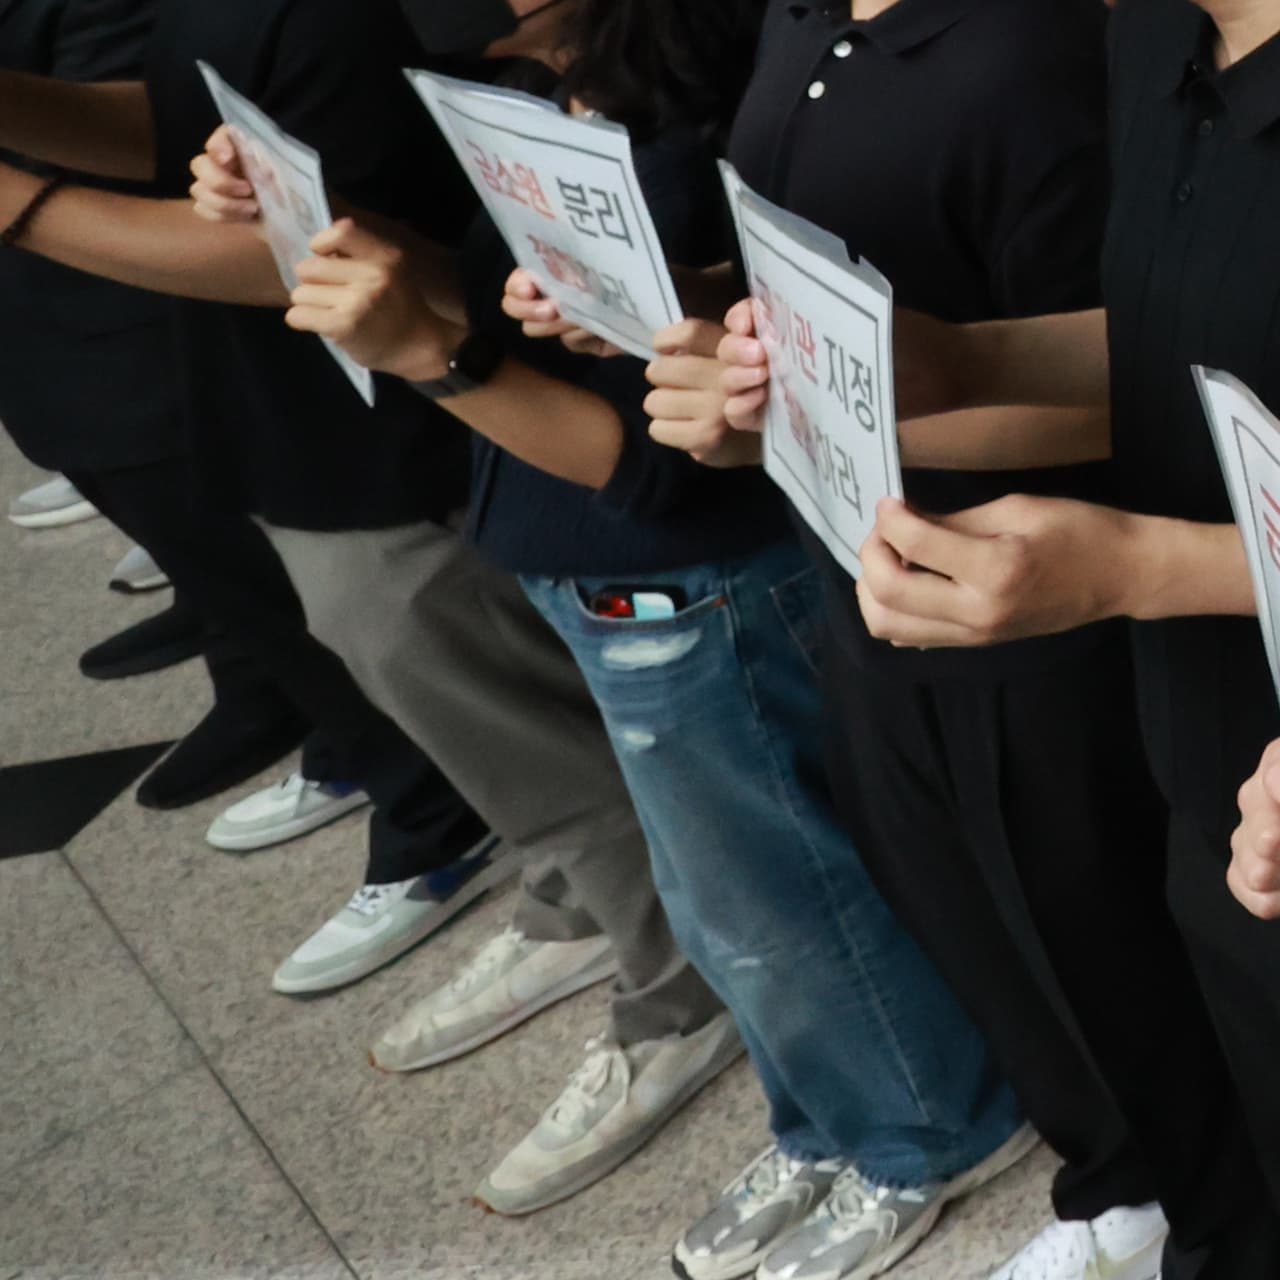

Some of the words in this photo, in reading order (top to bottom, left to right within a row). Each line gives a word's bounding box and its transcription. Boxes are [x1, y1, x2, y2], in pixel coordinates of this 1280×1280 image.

[465, 138, 558, 221] 금소원
[556, 176, 635, 250] 분리
[823, 334, 877, 434] 지정
